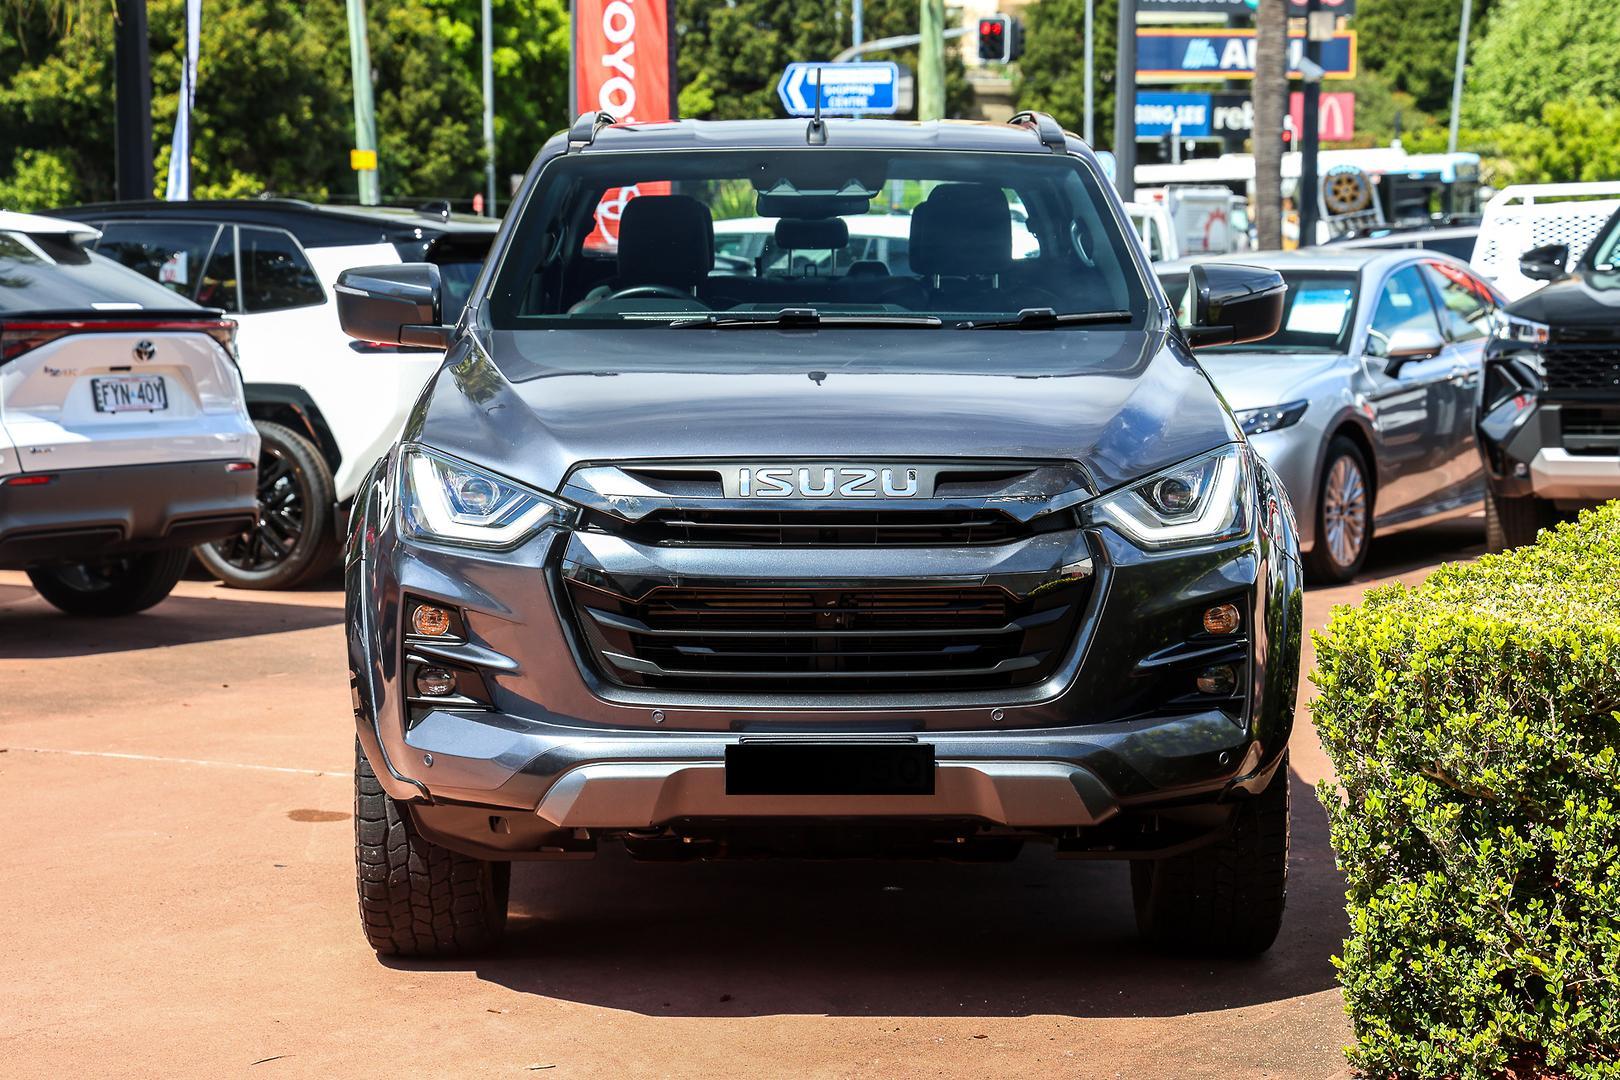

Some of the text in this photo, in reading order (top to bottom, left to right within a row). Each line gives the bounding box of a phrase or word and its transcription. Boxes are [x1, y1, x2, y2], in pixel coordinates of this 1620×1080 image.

[598, 0, 636, 123] OYO
[1213, 100, 1256, 130] reb
[739, 467, 918, 498] ISUZU
